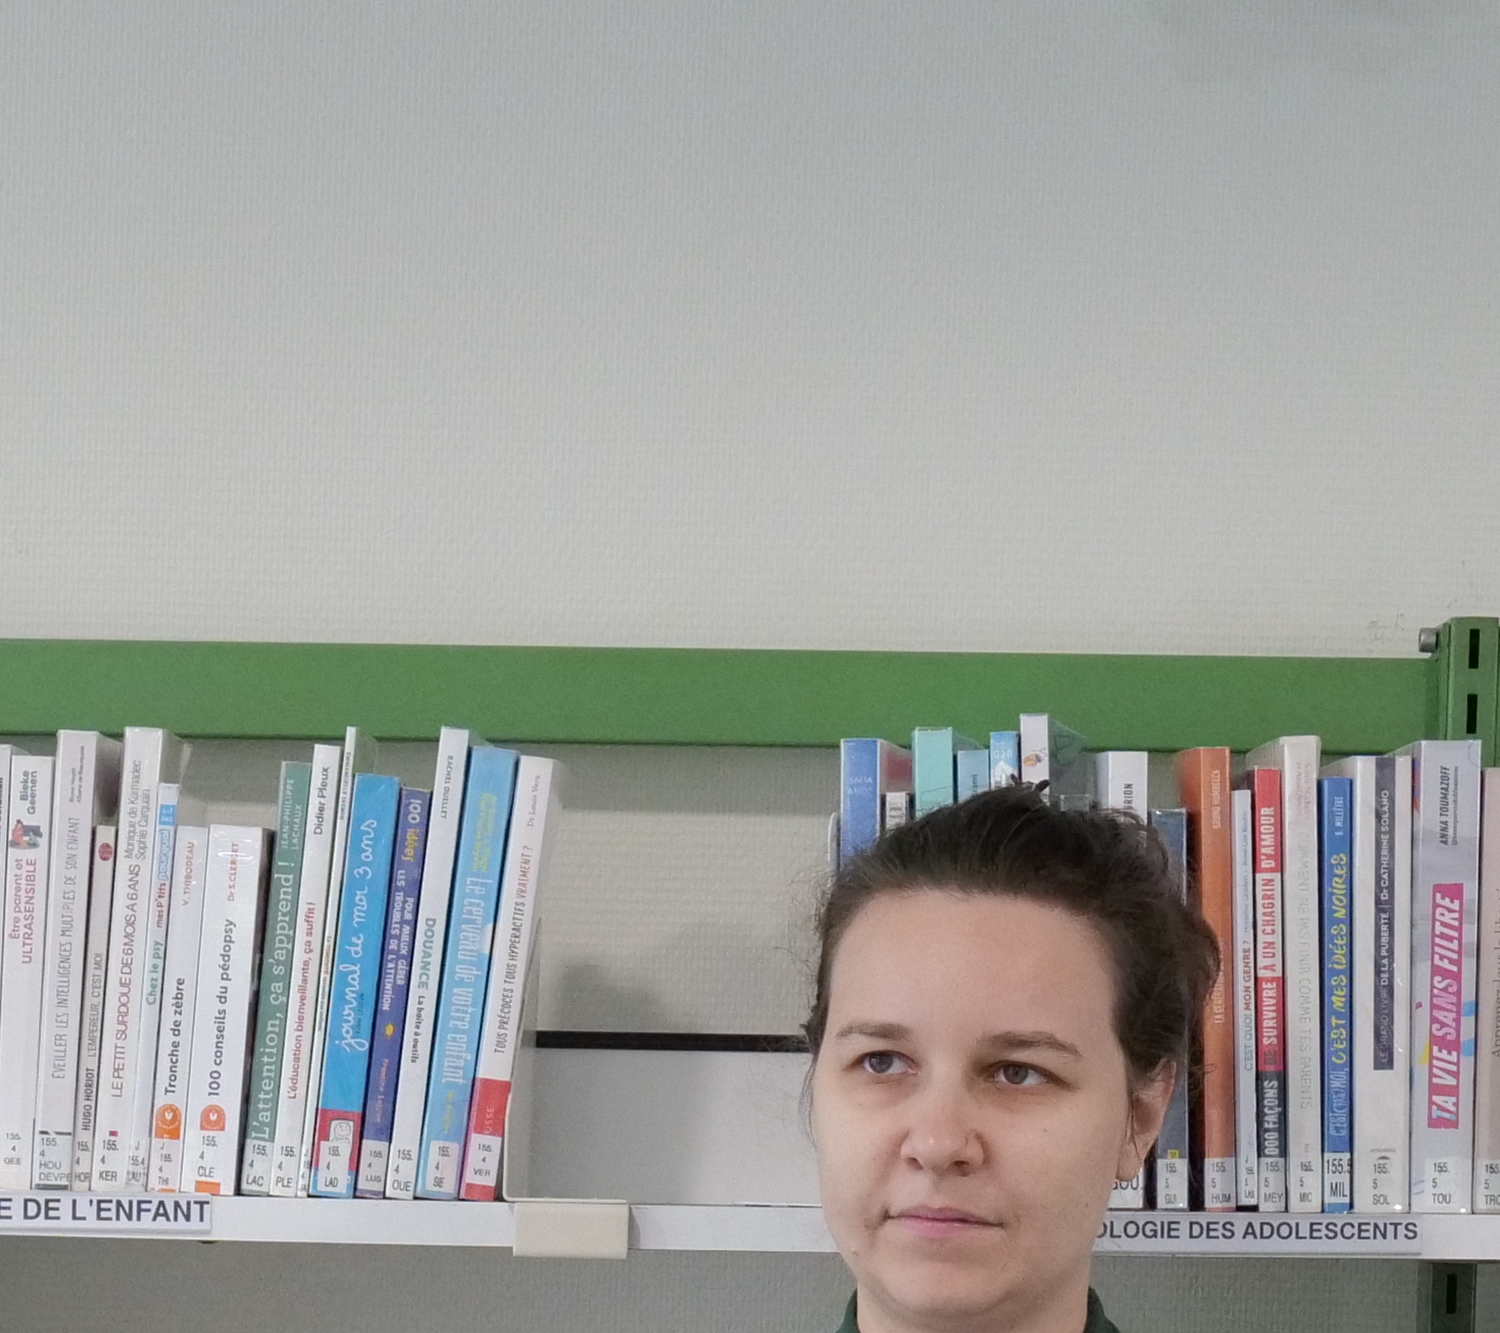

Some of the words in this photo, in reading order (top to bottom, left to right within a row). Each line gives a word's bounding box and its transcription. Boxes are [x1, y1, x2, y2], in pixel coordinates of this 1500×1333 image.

[219, 919, 237, 982] pédopsy
[1435, 892, 1461, 972] FILTRE
[171, 977, 185, 1016] zèbre
[218, 985, 228, 1004] du
[1433, 976, 1460, 1039] SANS
[169, 1020, 182, 1038] de
[212, 1007, 226, 1067] conseils
[165, 1040, 180, 1096] Tronche
[207, 1071, 221, 1097] 100
[1432, 1047, 1458, 1090] VIE
[1431, 1092, 1458, 1122] TA
[22, 1196, 62, 1222] DE
[71, 1198, 210, 1225] L'ENFANT
[1188, 1219, 1236, 1241] DES
[1241, 1222, 1418, 1243] ADOLESCENTS
